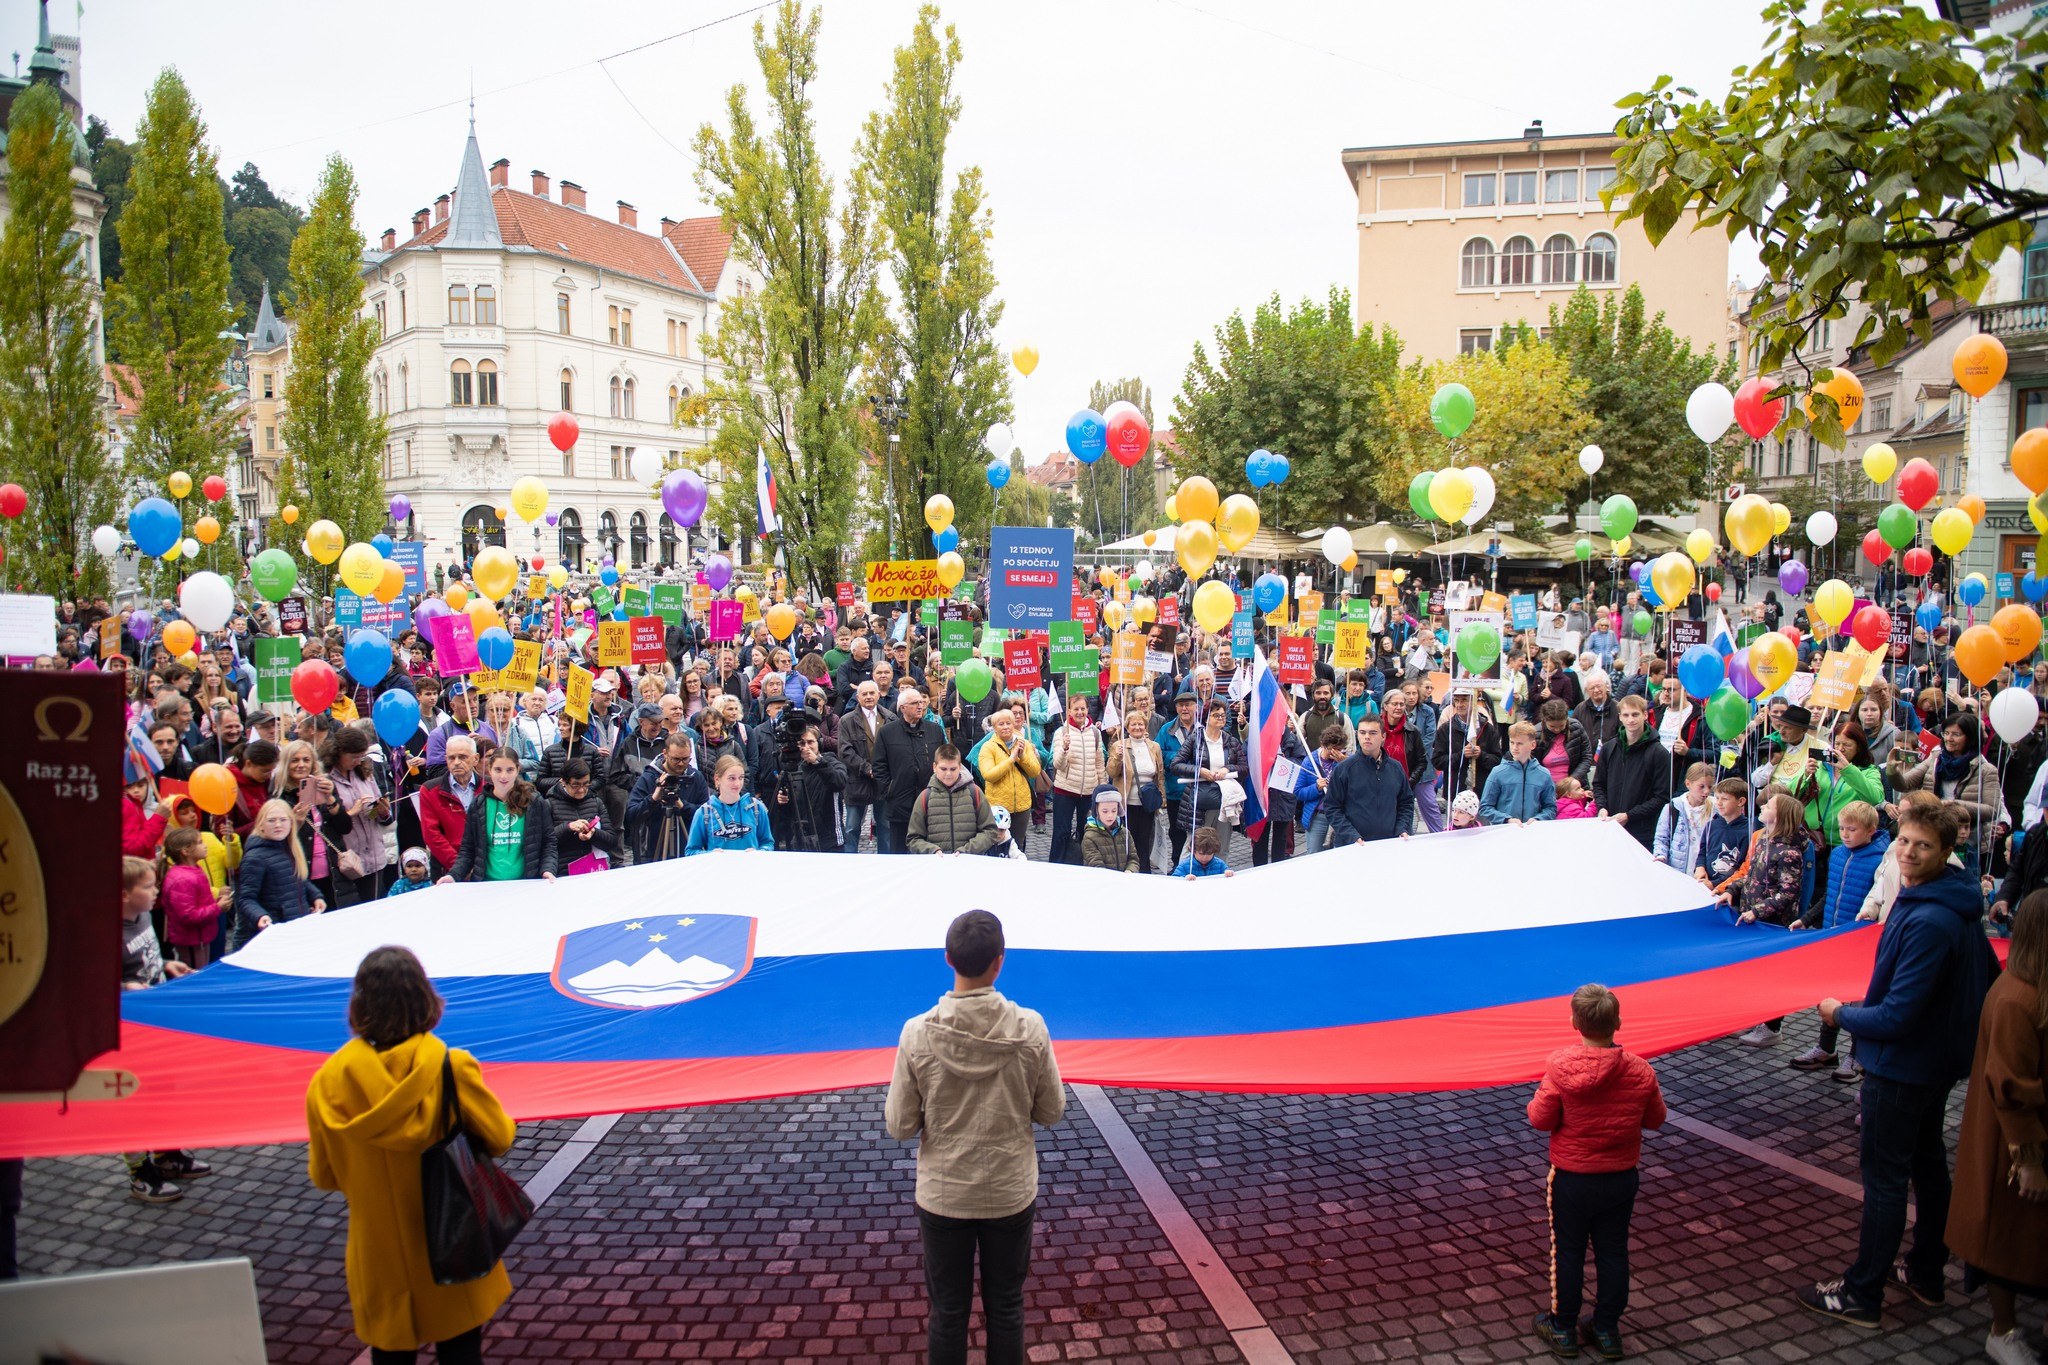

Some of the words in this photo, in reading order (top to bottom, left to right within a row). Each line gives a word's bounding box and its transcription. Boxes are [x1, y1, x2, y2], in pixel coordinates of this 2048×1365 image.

[1010, 546, 1018, 554] 12
[1019, 546, 1054, 555] TEDNOV
[1003, 558, 1015, 566] PO
[1016, 558, 1060, 568] SPOČETJU
[868, 562, 918, 583] Noseče
[1010, 574, 1020, 582] SE
[1021, 574, 1046, 583] SMEJI
[873, 585, 897, 598] so
[338, 600, 360, 608] HEARTS
[605, 627, 625, 636] SPLAV
[1234, 628, 1252, 637] HEARTS
[1341, 628, 1360, 637] SPLAV
[610, 636, 621, 648] NI
[635, 633, 658, 642] VREDEN
[1887, 634, 1912, 645] OVEK!
[632, 642, 662, 651] ŽIVLJENJA!
[942, 640, 972, 649] ŽIVLJENJE!
[1051, 644, 1082, 653] ŽIVLJENJE!
[1345, 637, 1355, 650] NI
[513, 646, 534, 659] SPLAV
[604, 648, 627, 657] ZDRAV!
[1339, 649, 1361, 659] ZDRAV!
[1011, 658, 1033, 666] VREDEN
[1285, 654, 1306, 662] VREDEN
[514, 658, 527, 671] NI
[1281, 661, 1310, 671] ŽIVLJENJA!
[505, 669, 531, 681] ZDRAV!
[1008, 666, 1038, 676] ŽIVLJENJA!
[1070, 670, 1097, 679] ŽIVLJENJE!
[477, 671, 499, 683] ZDRAV
[573, 672, 587, 687] SPLAV
[574, 683, 583, 698] NI
[569, 694, 585, 710] ZDRAV!
[26, 761, 63, 779] Raz
[67, 765, 97, 783] 22,
[54, 782, 99, 802] 12-13
